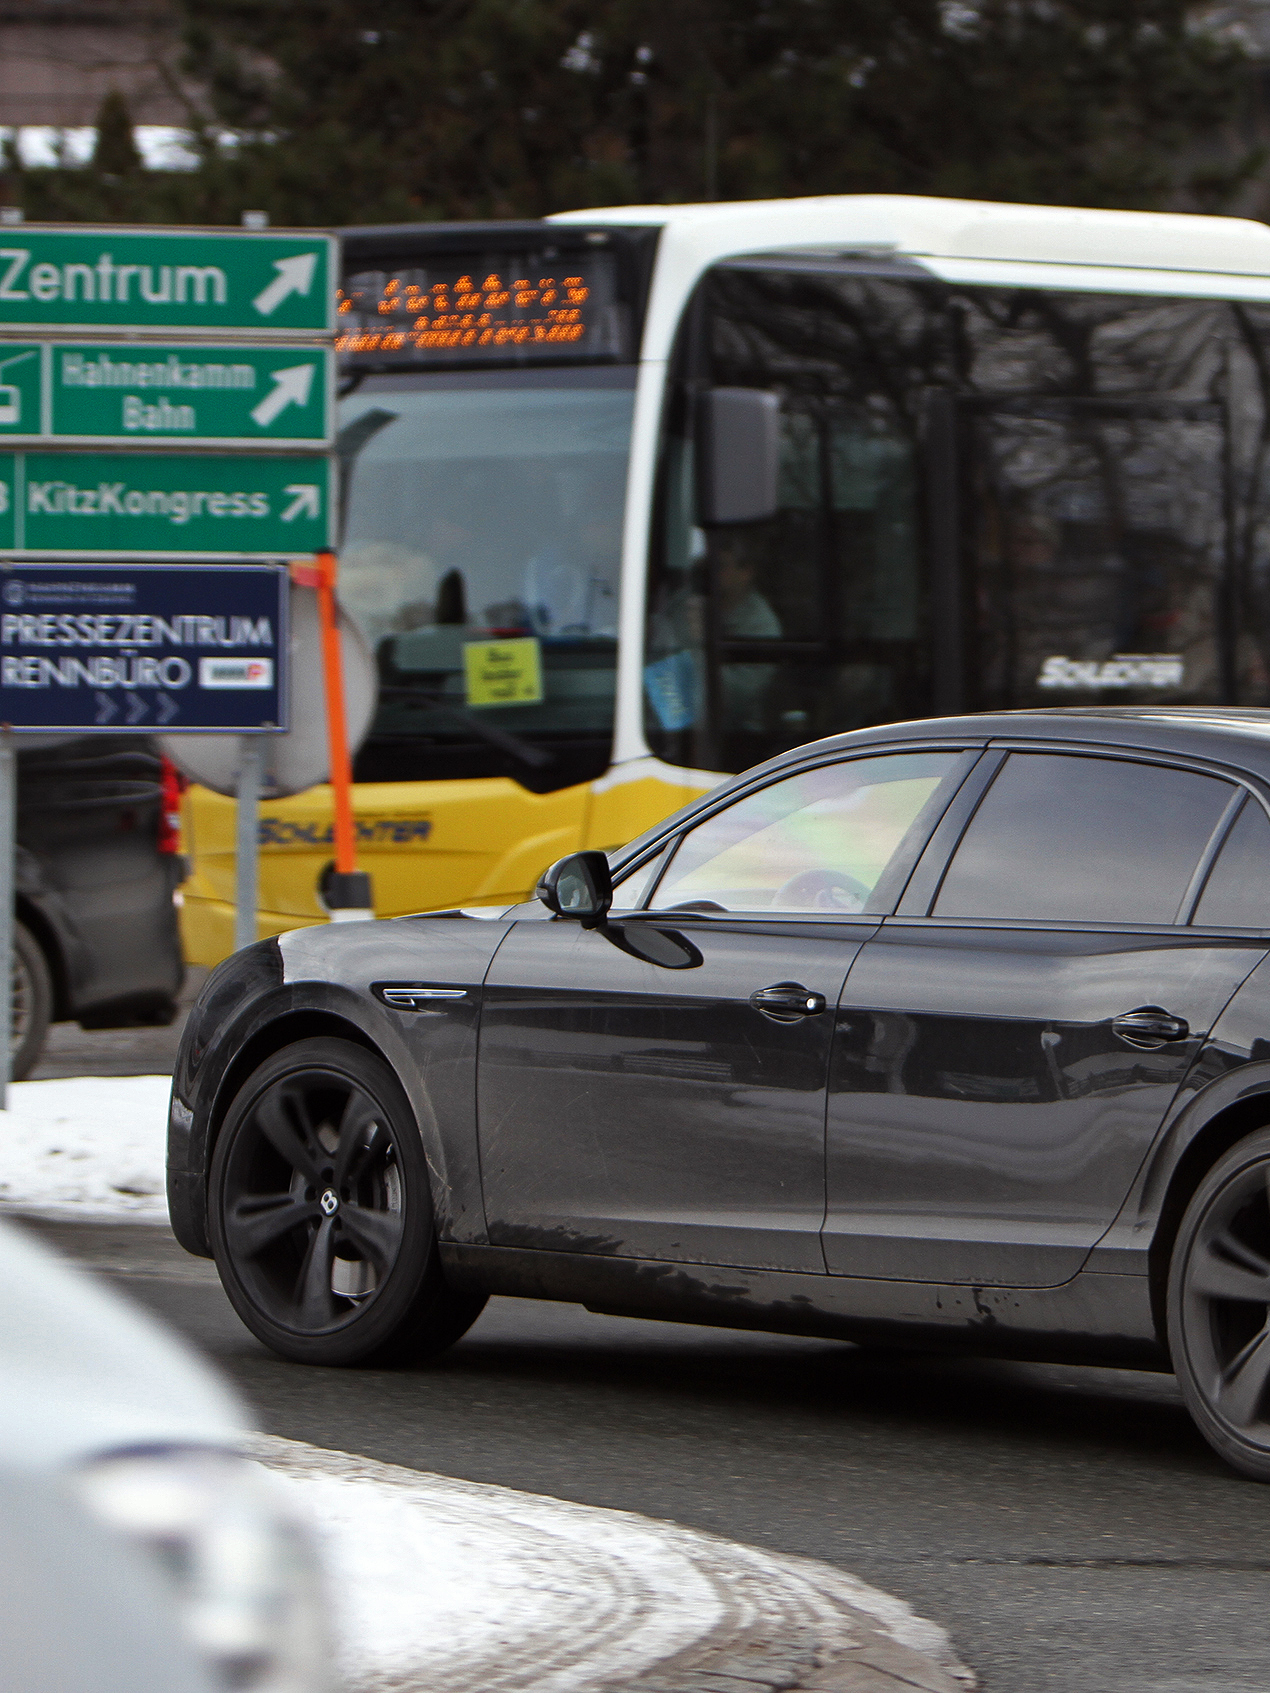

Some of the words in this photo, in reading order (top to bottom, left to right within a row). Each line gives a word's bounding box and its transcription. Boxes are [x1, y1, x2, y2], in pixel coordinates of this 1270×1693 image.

[0, 249, 227, 303] Zentrum
[62, 353, 256, 388] Hahnenkamm
[122, 395, 196, 430] Bahn
[28, 482, 271, 524] KitzKongress
[1, 613, 274, 647] PRESSEZENTRUM
[1, 650, 193, 689] RENNBÜRO
